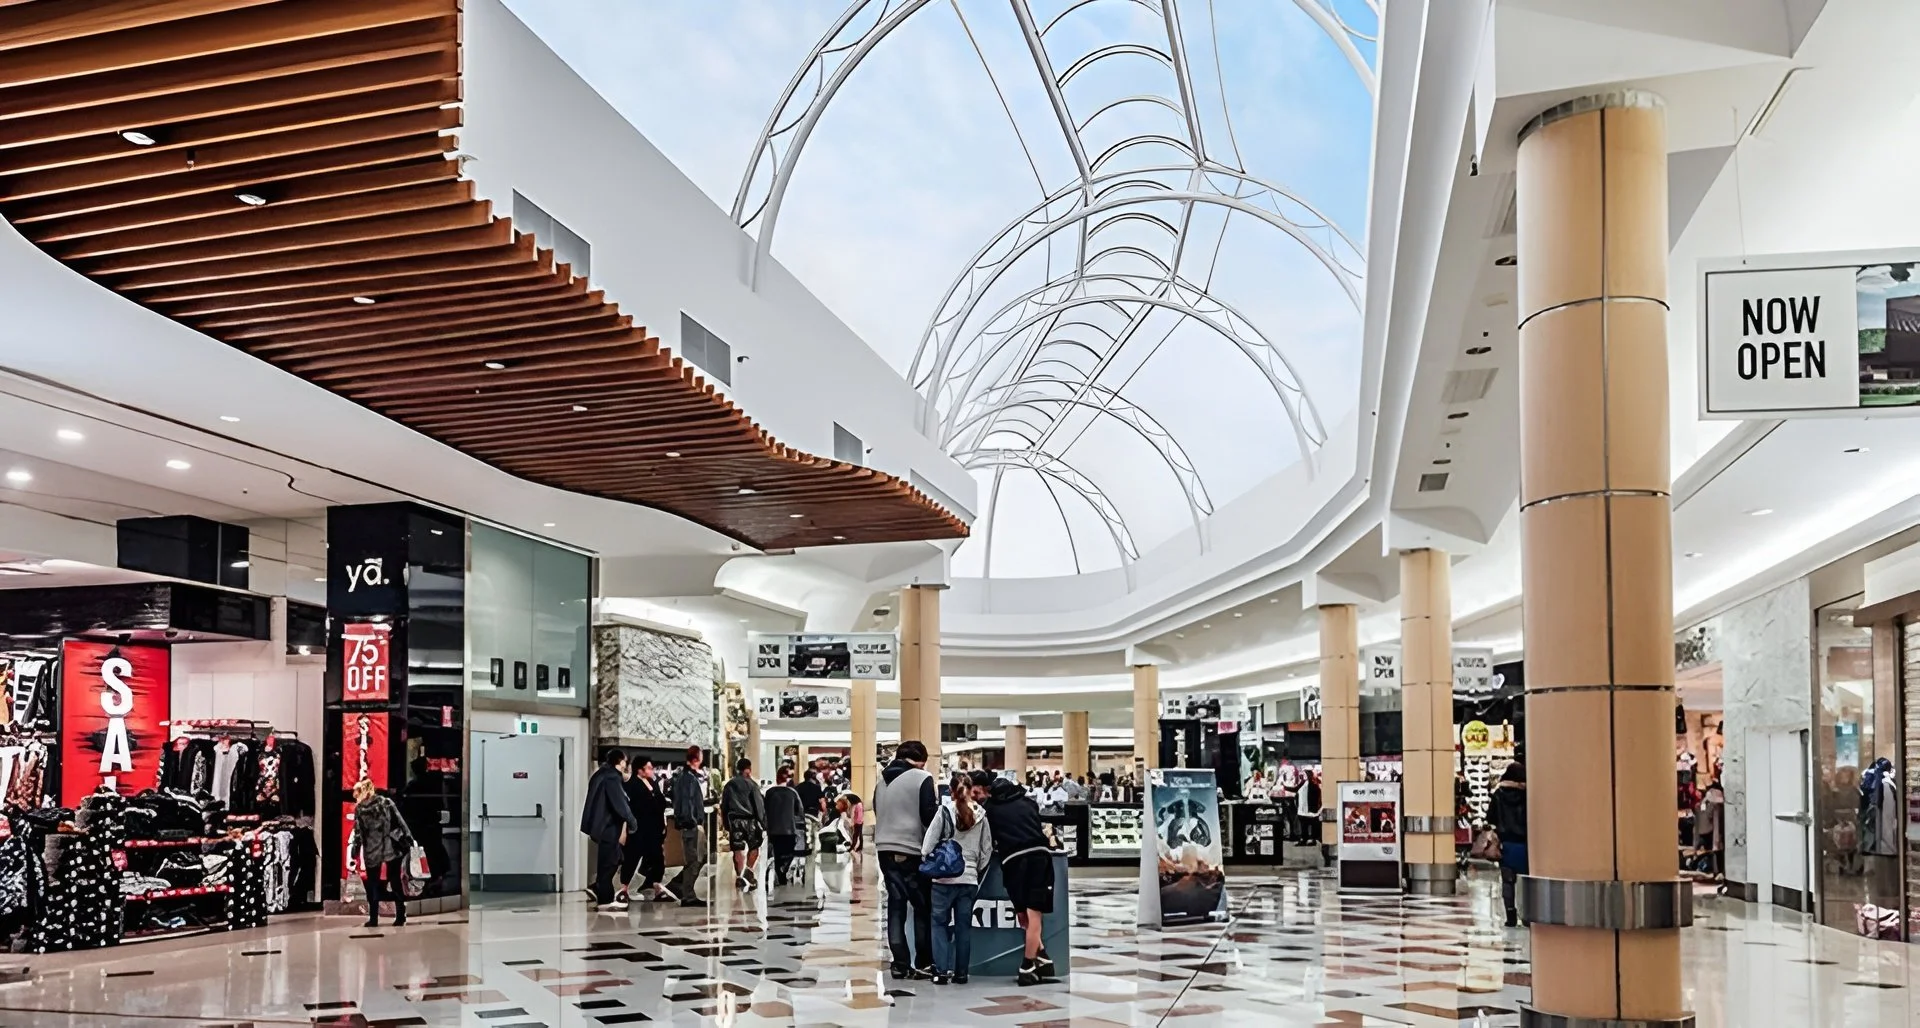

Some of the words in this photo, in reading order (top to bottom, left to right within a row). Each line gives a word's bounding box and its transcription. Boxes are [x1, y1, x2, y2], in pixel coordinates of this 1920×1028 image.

[1742, 296, 1820, 336] NOW
[1737, 340, 1826, 380] OPEN
[347, 666, 386, 691] OFF
[99, 657, 135, 792] SA
